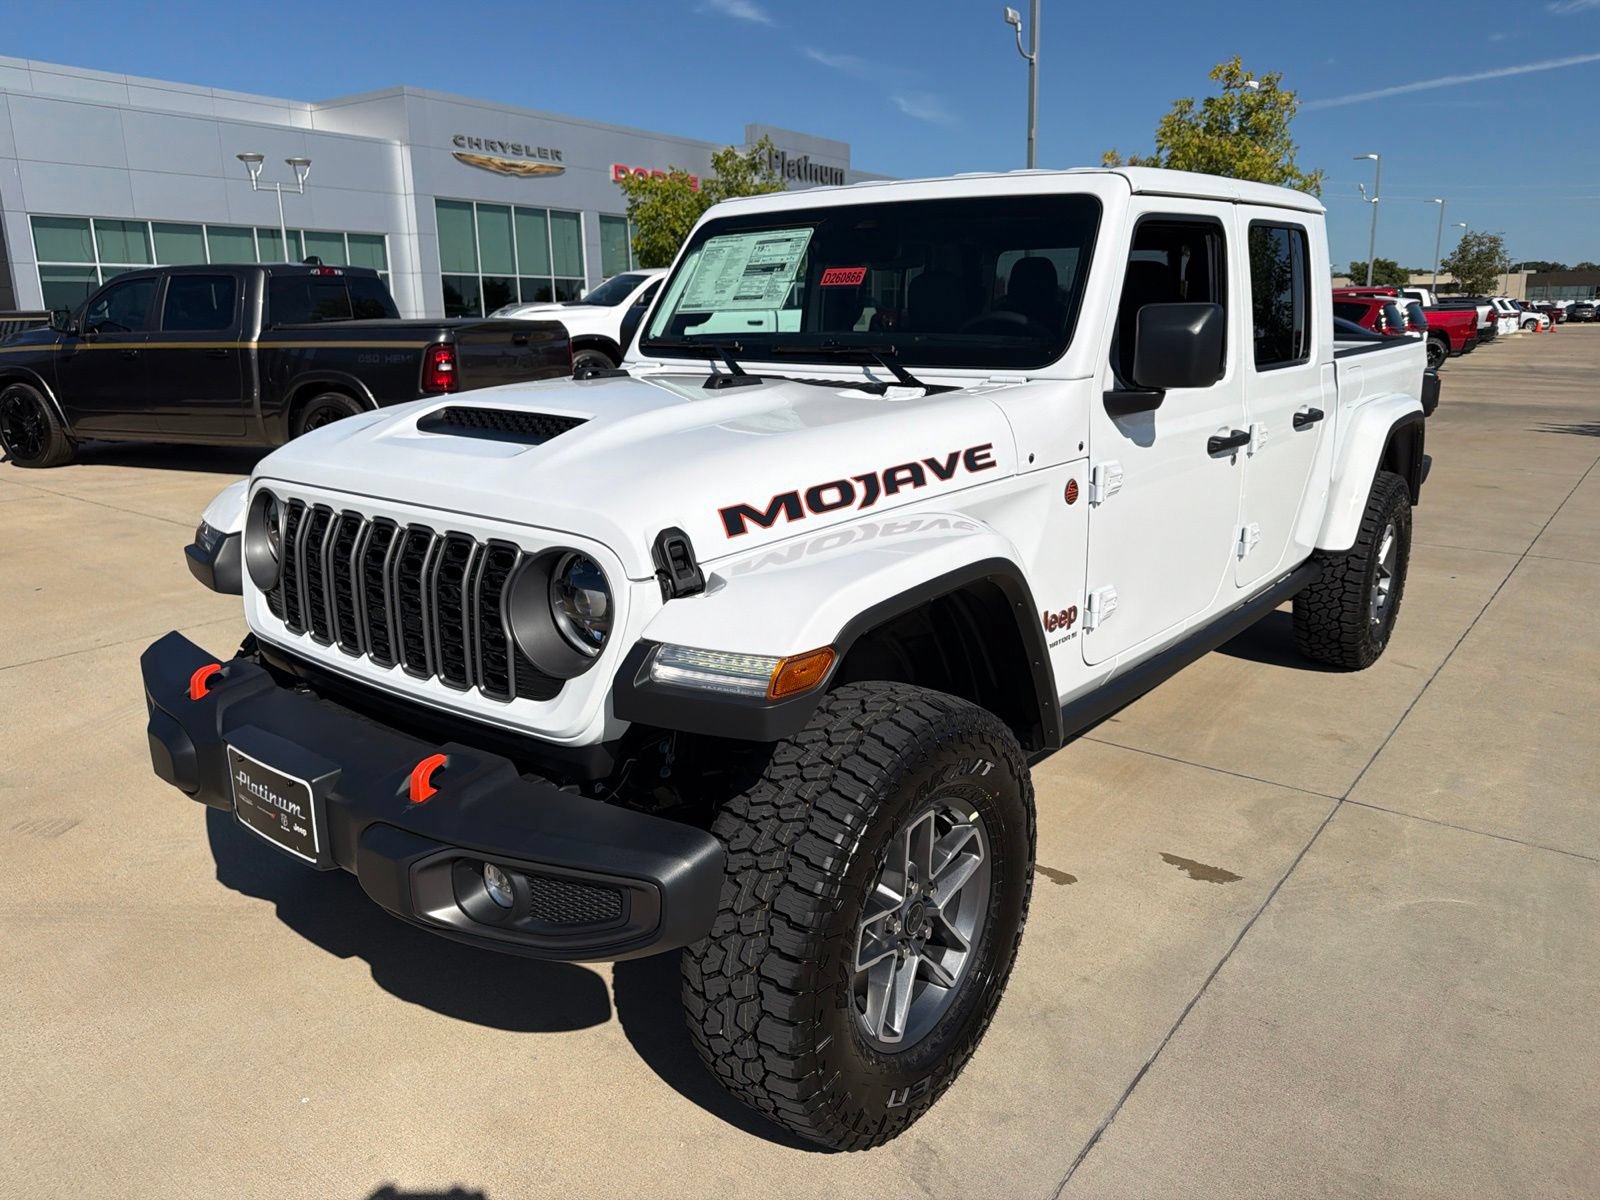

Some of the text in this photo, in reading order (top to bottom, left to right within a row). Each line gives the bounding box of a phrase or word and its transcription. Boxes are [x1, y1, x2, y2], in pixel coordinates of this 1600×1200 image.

[452, 134, 562, 161] CHRYSLER
[767, 149, 846, 186] Platinum
[823, 271, 863, 284] D260866
[717, 442, 997, 539] MOJAVE
[235, 770, 307, 820] Platinum
